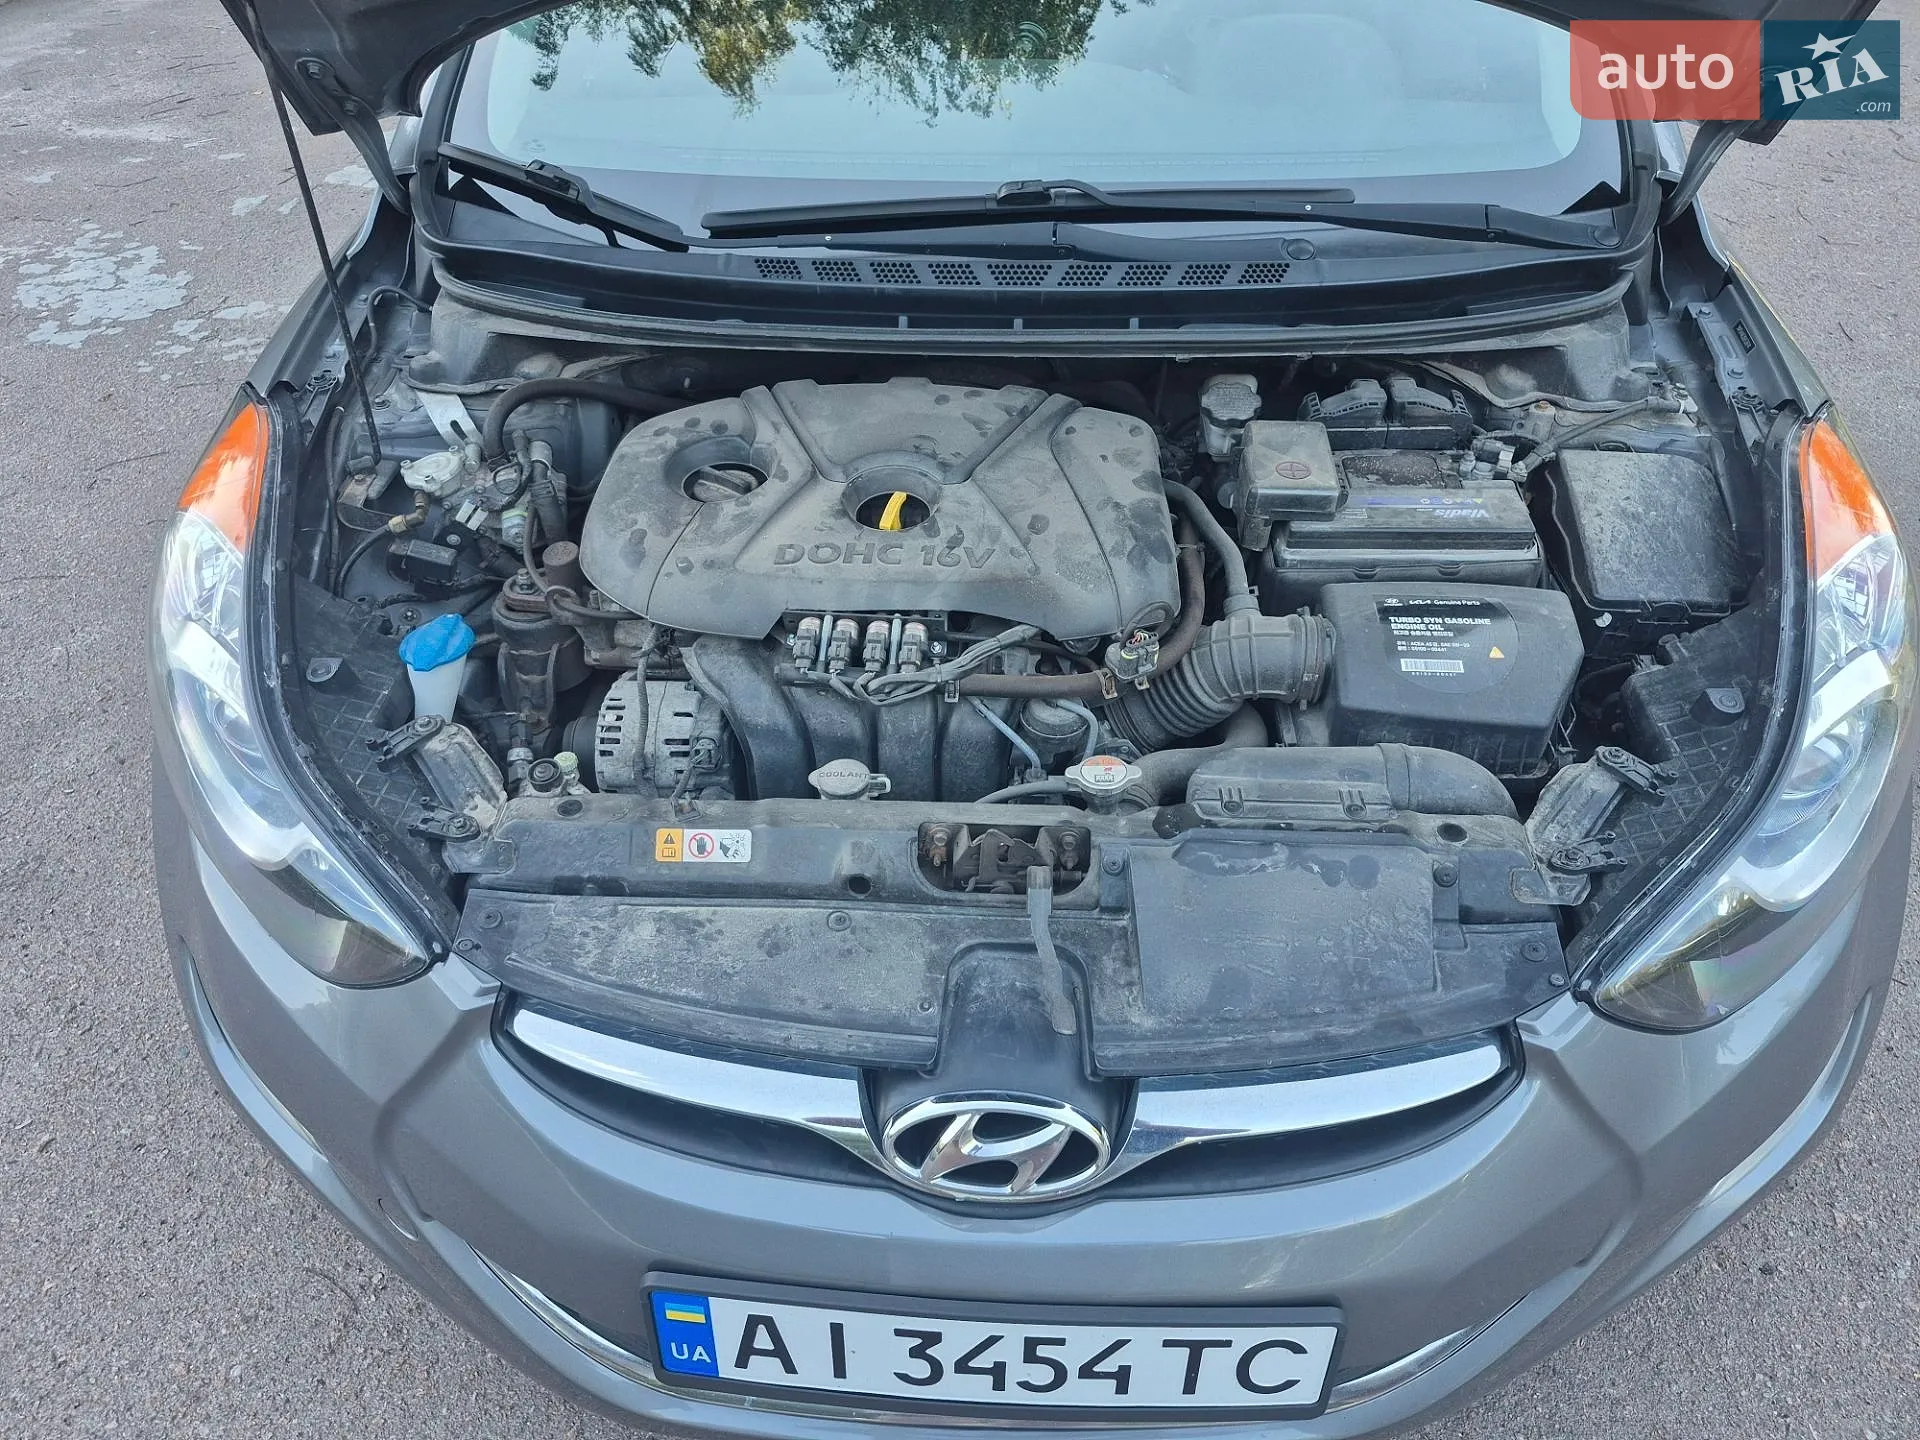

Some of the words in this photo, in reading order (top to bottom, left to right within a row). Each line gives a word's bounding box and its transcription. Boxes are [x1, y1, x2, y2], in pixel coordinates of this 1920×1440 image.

[773, 542, 904, 566] DOHC
[920, 544, 996, 568] 16V
[818, 770, 870, 779] COOLANT
[670, 1342, 712, 1364] UA
[734, 1313, 848, 1379] AI
[893, 1327, 1133, 1396] 3454
[1161, 1338, 1309, 1396] TC
